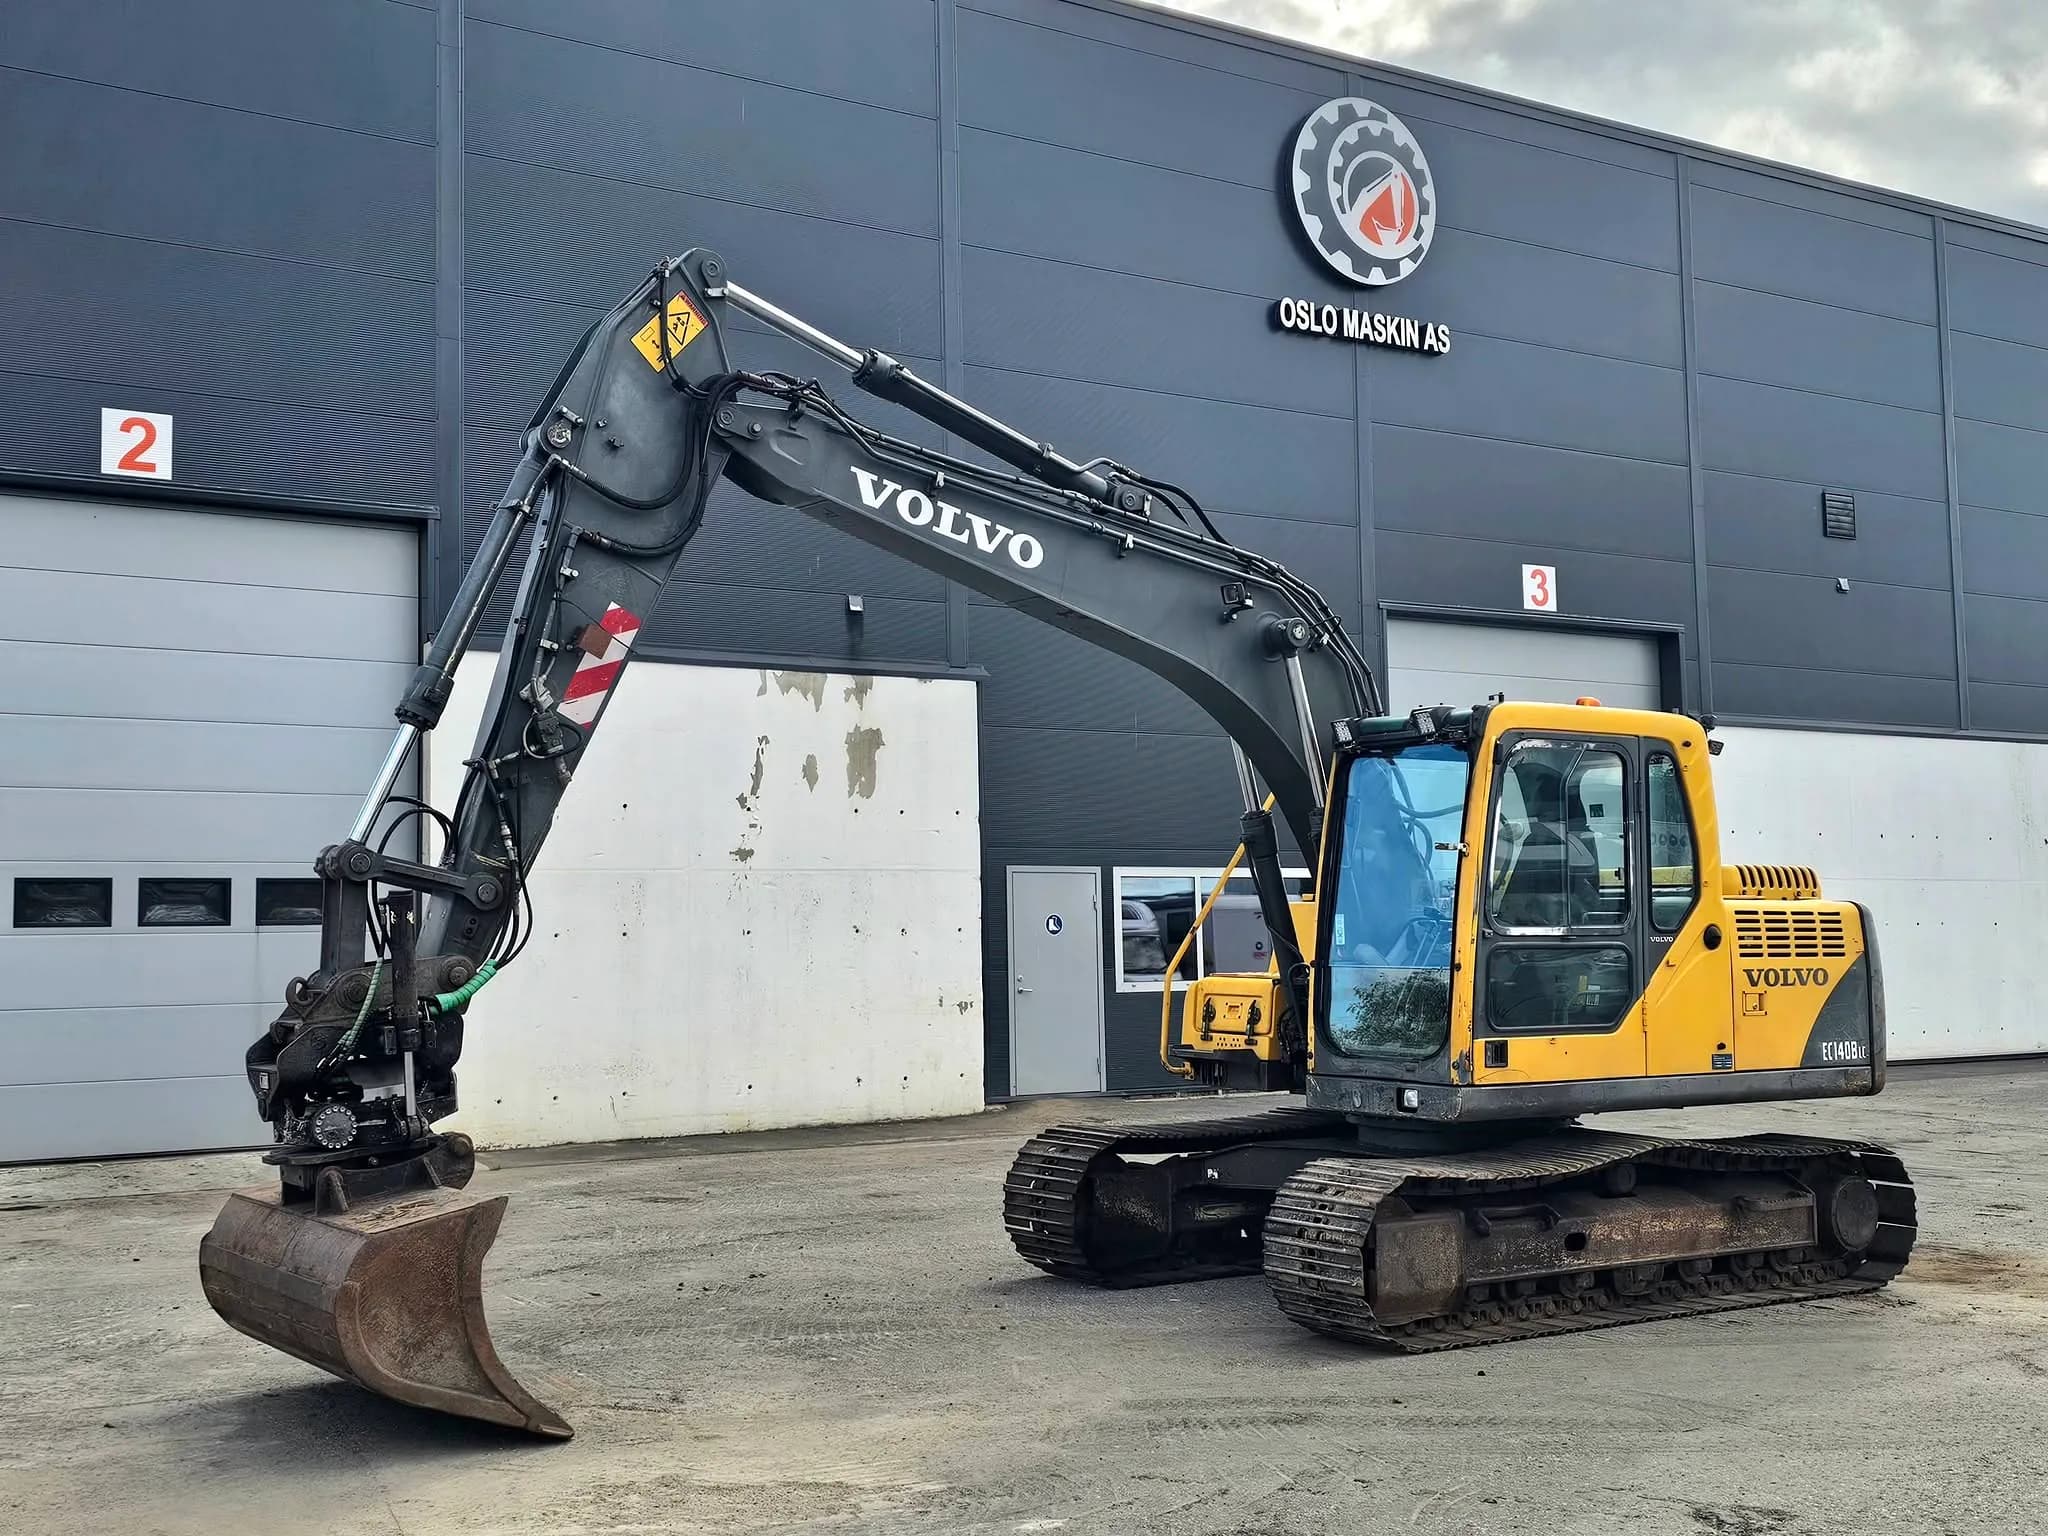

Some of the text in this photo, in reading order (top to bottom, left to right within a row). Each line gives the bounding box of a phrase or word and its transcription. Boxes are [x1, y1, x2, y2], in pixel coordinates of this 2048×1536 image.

[1280, 297, 1451, 354] OSLO MASKIN AS
[117, 416, 157, 473] 2
[850, 465, 1045, 569] VOLVO
[1530, 568, 1549, 607] 3
[1742, 967, 1829, 987] VOLVO
